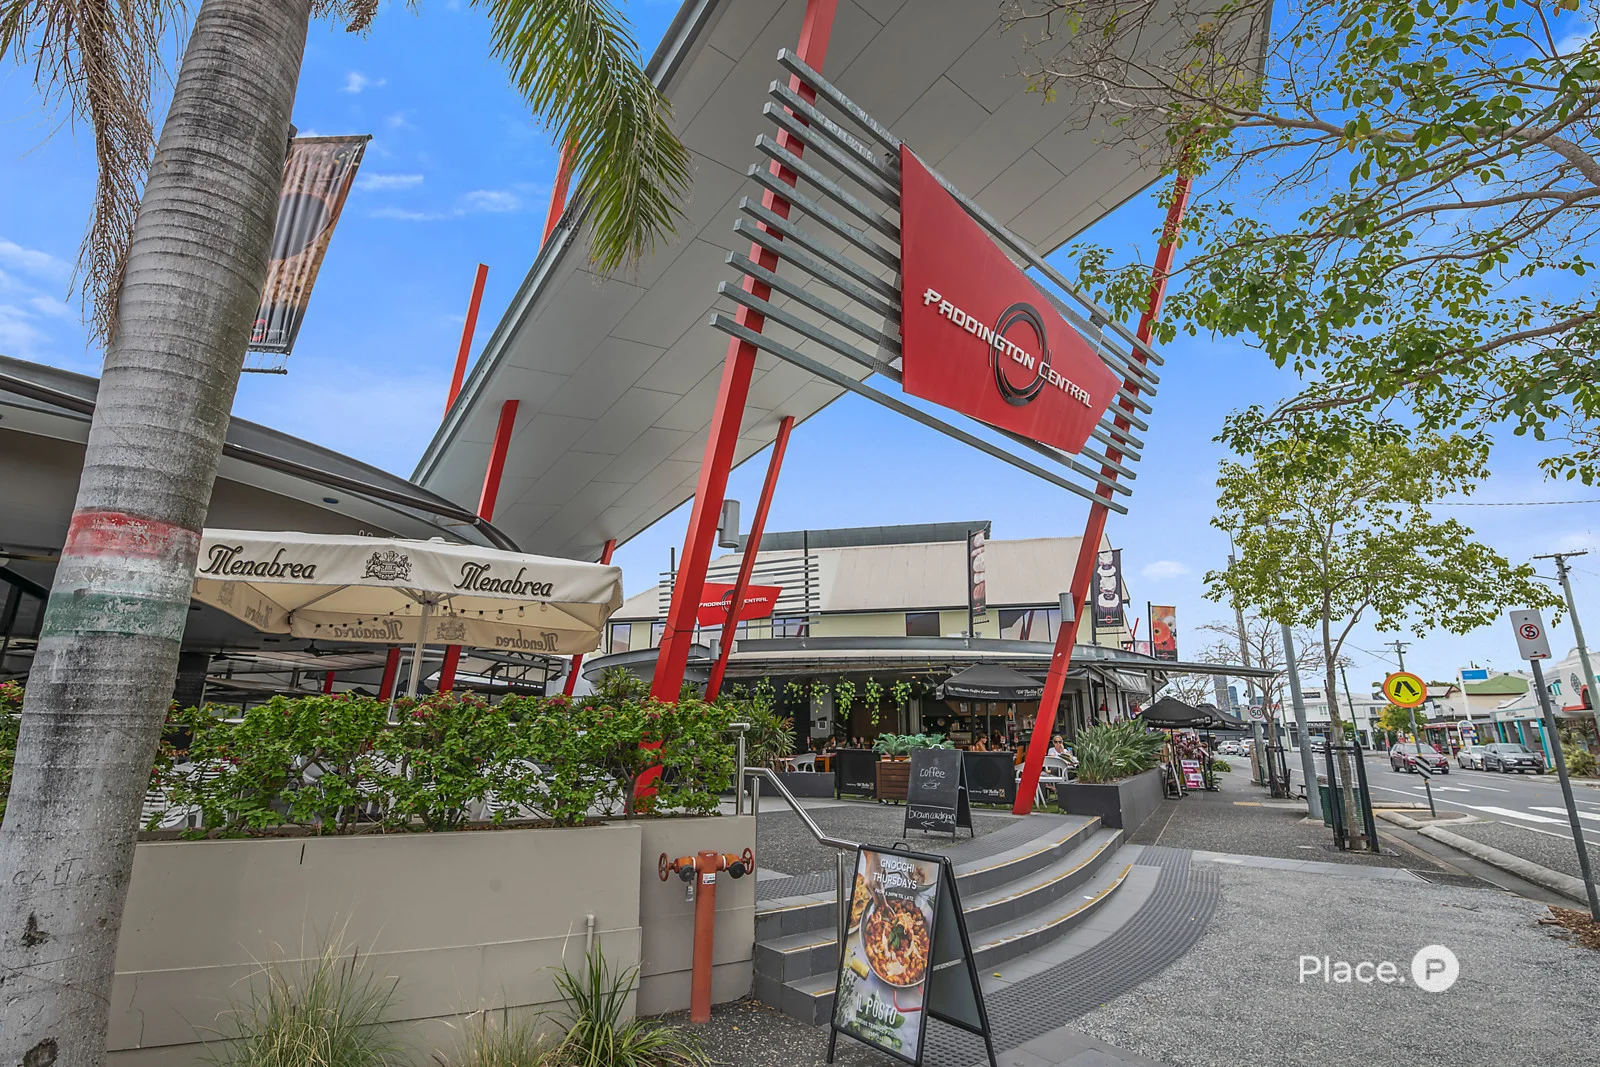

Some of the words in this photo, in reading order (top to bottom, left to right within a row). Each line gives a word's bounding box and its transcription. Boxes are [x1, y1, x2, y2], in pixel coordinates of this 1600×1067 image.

[923, 288, 1035, 370] PADDINGTON
[1038, 361, 1092, 408] CENTRAL
[199, 544, 318, 579] Menabrea
[454, 562, 554, 597] Menabrea
[698, 600, 731, 608] PADDINGT
[1251, 709, 1262, 717] 50
[920, 766, 946, 779] coffee
[880, 859, 915, 873] GNOCCHI
[873, 872, 917, 890] THURSDAYS
[865, 997, 897, 1025] POSTO
